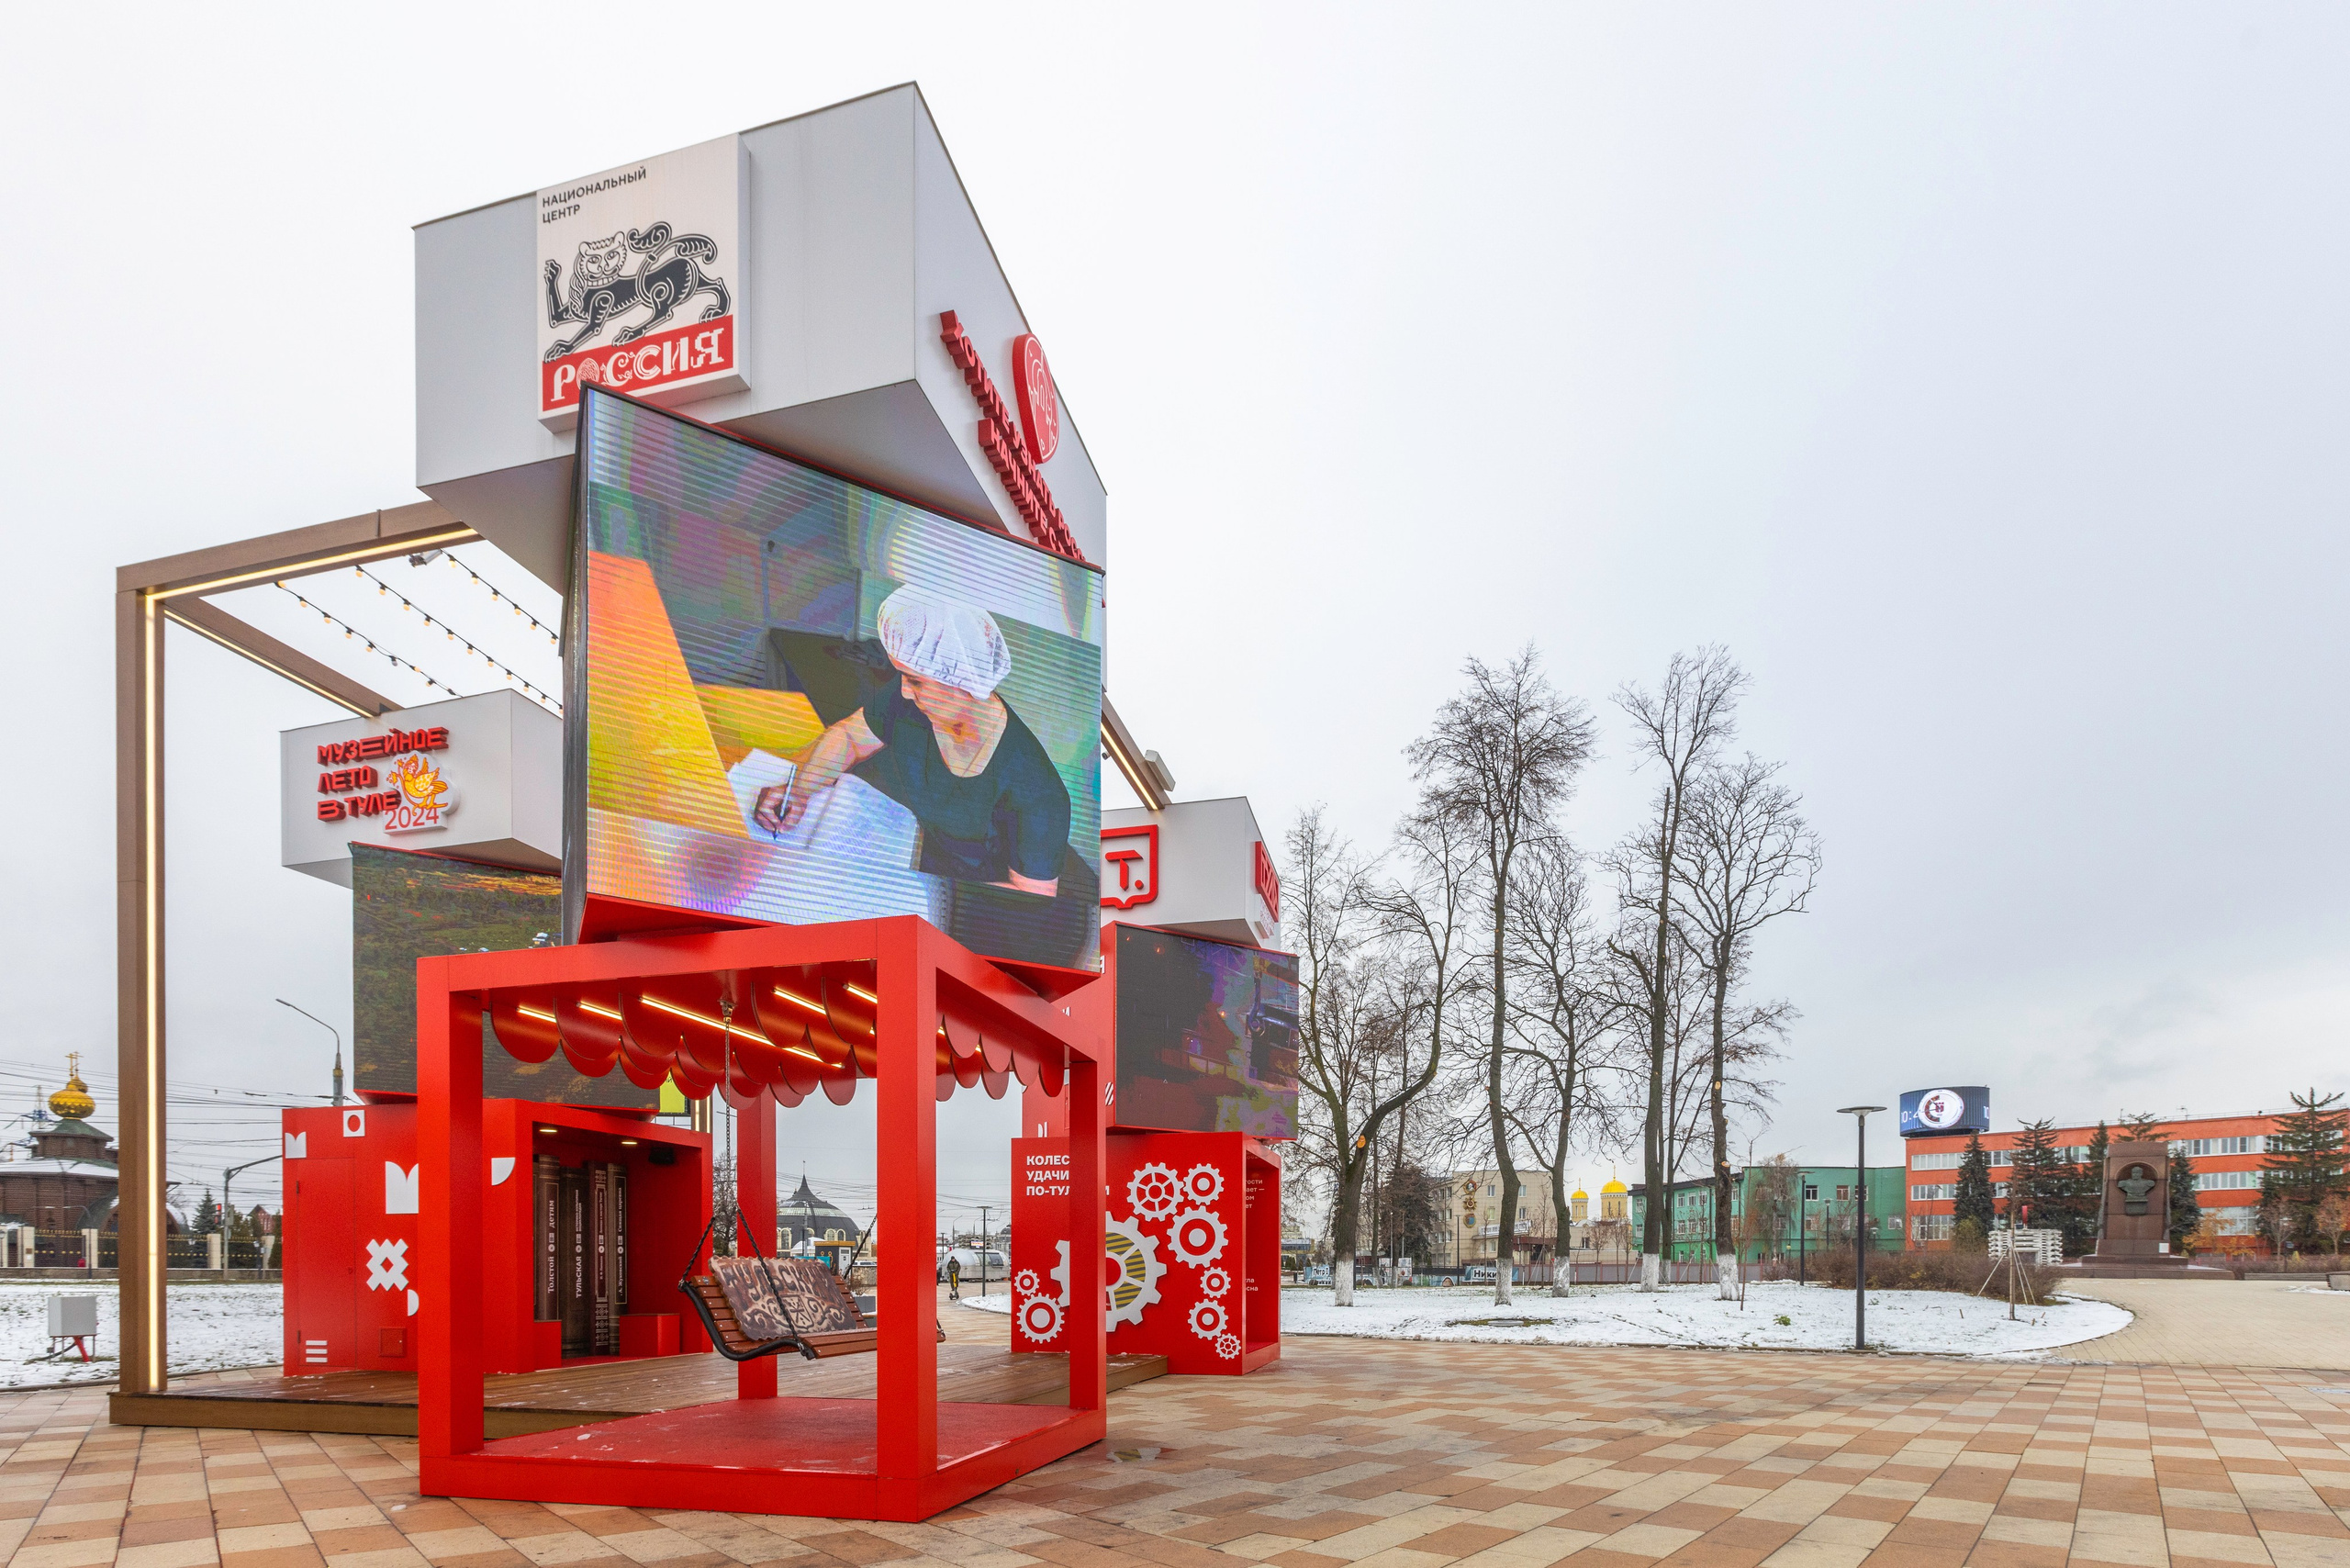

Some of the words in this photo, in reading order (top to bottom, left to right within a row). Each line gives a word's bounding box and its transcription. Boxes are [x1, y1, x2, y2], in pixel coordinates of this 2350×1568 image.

[543, 166, 647, 207] НАЦИОНАЛЬНЫЙ
[543, 204, 580, 224] ЦЕНТР
[551, 328, 724, 402] РОССИЯ
[942, 309, 1011, 432] ХОТИТЕ
[1007, 421, 1057, 520] УЗНАТЬ
[981, 418, 1047, 538] НАЧНИТЕ
[318, 726, 448, 766] МУЗЕЙНОЕ
[318, 765, 377, 794] ЛЕТО
[318, 800, 345, 822] В
[344, 790, 400, 817] ТУЛЕ
[385, 805, 439, 830] 2024
[1026, 1155, 1069, 1166] КОЛЕС
[1026, 1170, 1069, 1182] УДАЧИ
[1473, 1270, 1496, 1278] Ники
